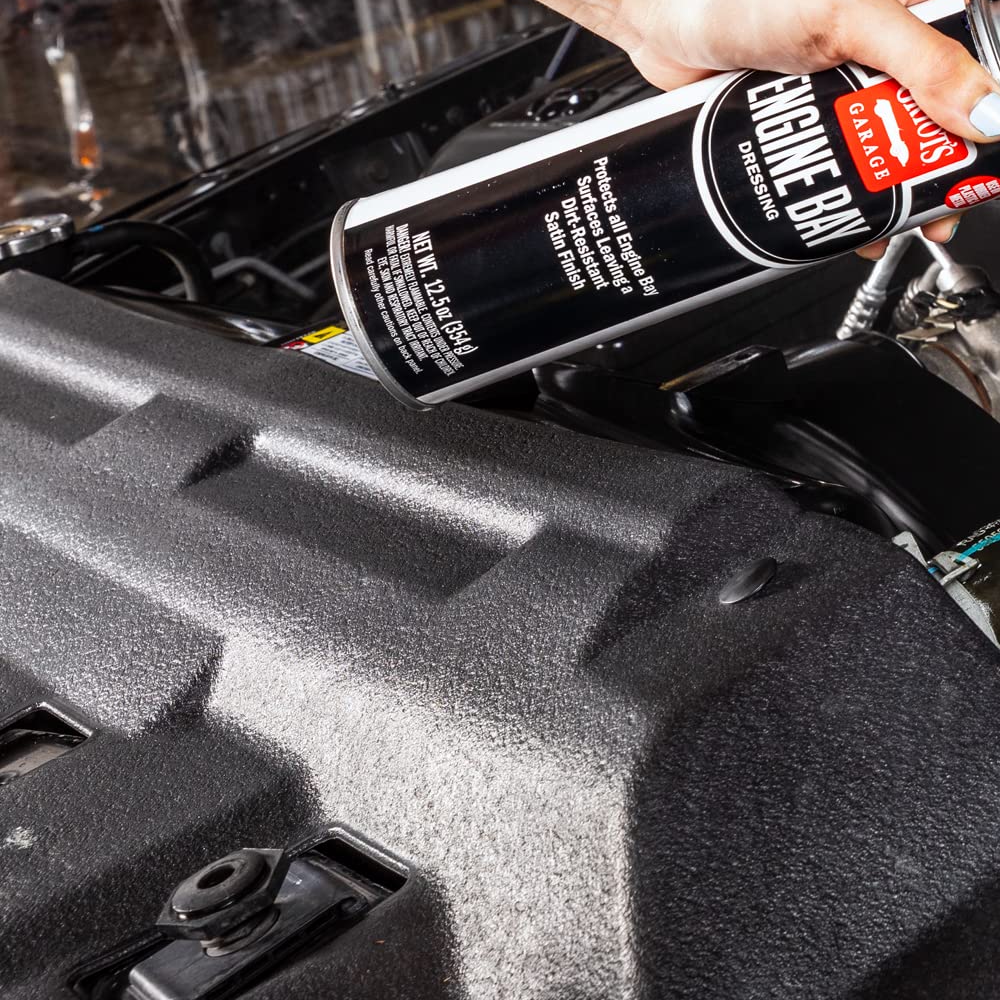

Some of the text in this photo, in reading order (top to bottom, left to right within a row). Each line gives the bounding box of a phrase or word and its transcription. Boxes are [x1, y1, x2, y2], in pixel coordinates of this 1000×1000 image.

[849, 102, 890, 180] GARAGE
[746, 73, 872, 248] ENGINE BAY
[738, 140, 780, 221] DRESSING
[577, 175, 634, 295] Surfaces Leaving a
[593, 156, 659, 297] Protects all Engine Bay
[396, 223, 411, 253] DANGER!
[412, 230, 433, 254] NET
[561, 197, 609, 290] Dirt-Resistant
[364, 248, 375, 266] Read
[386, 246, 398, 256] OR
[545, 211, 586, 291] Satin Finish
[388, 254, 400, 271] FATAL
[391, 268, 402, 276] IF
[400, 252, 416, 282] EXTREMELY
[417, 253, 438, 278] WT.
[366, 264, 381, 292] carefully
[379, 267, 392, 283] SKIN
[383, 281, 396, 294] AND
[374, 292, 386, 310] other
[387, 293, 409, 327] RESPIRATORY
[381, 310, 398, 338] cautions
[405, 308, 420, 322] KEEP
[420, 313, 441, 338] CONTENTS
[401, 325, 417, 341] TRACT
[411, 321, 425, 333] OUT
[417, 331, 429, 339] OF
[393, 336, 403, 346] on
[421, 337, 438, 354] REACH
[433, 335, 450, 353] UNDER
[398, 344, 412, 361] back
